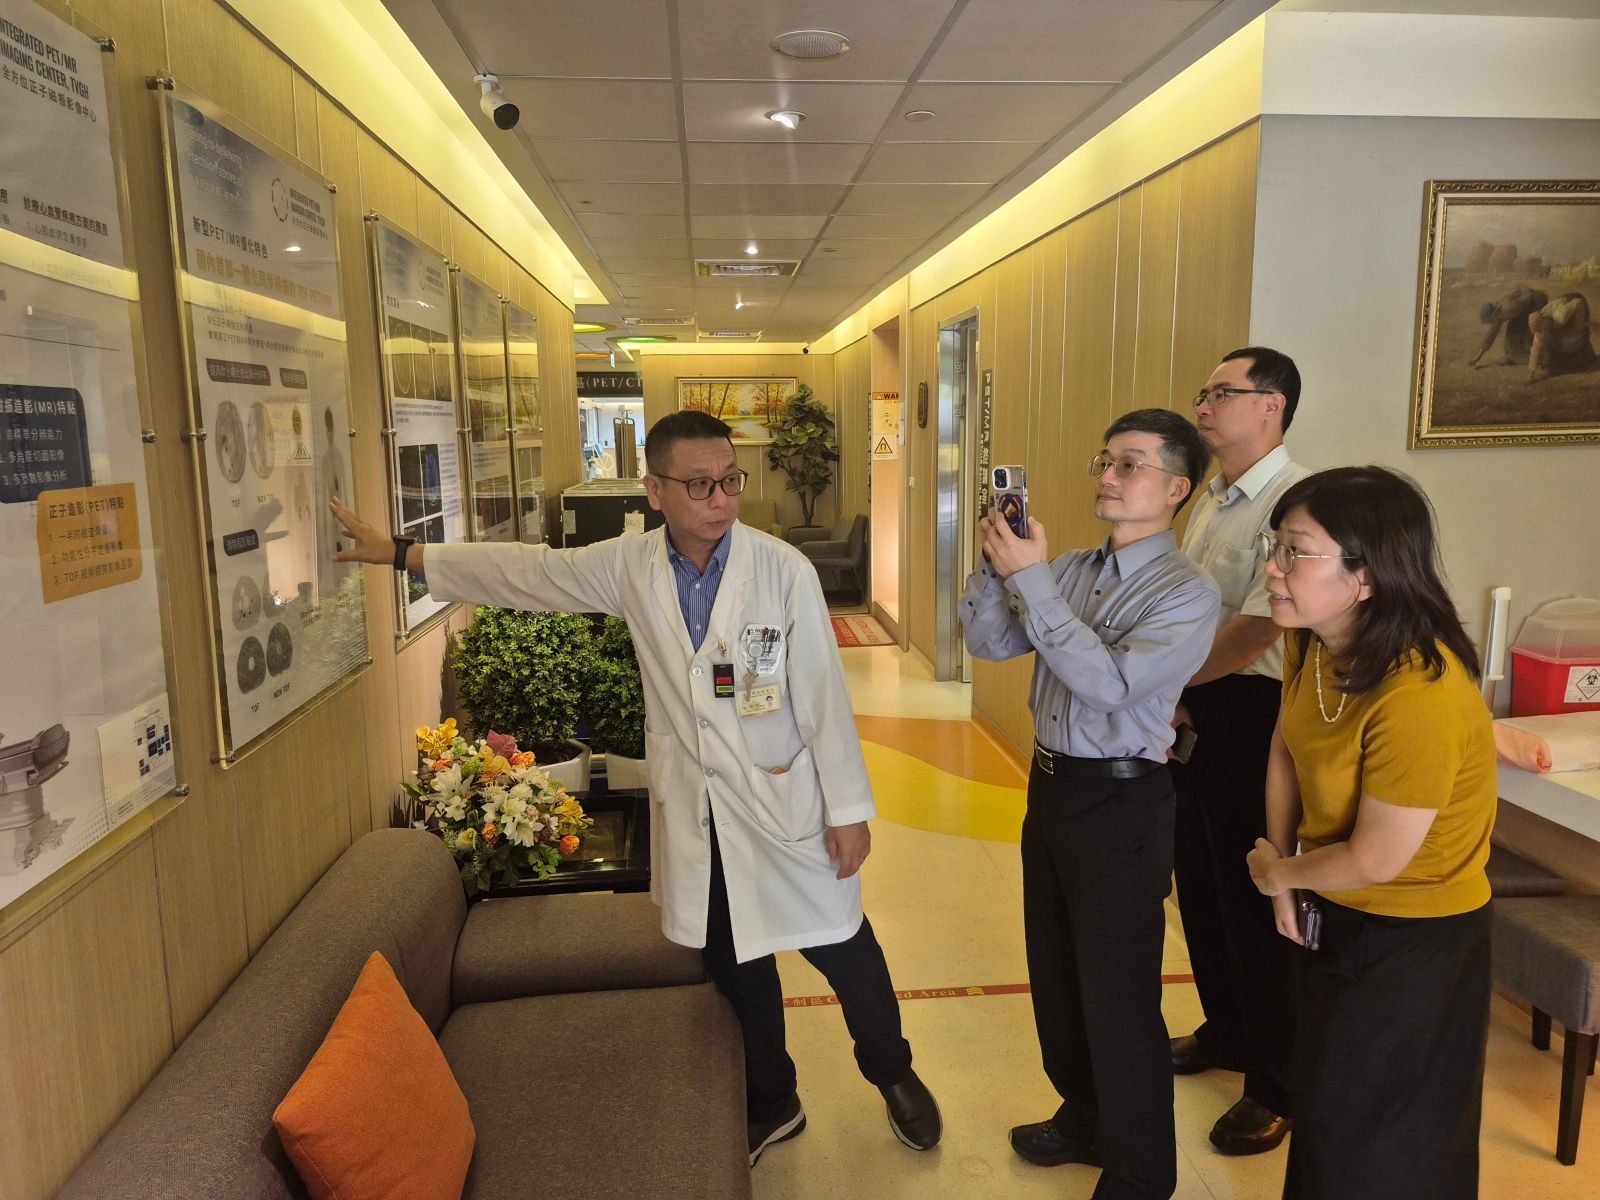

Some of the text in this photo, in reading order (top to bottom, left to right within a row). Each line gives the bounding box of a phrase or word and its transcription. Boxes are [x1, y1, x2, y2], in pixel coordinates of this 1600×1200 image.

[45, 44, 78, 73] PET/MR
[35, 60, 70, 92] CENTER,
[70, 77, 89, 100] TVGH
[920, 990, 956, 998] Area
